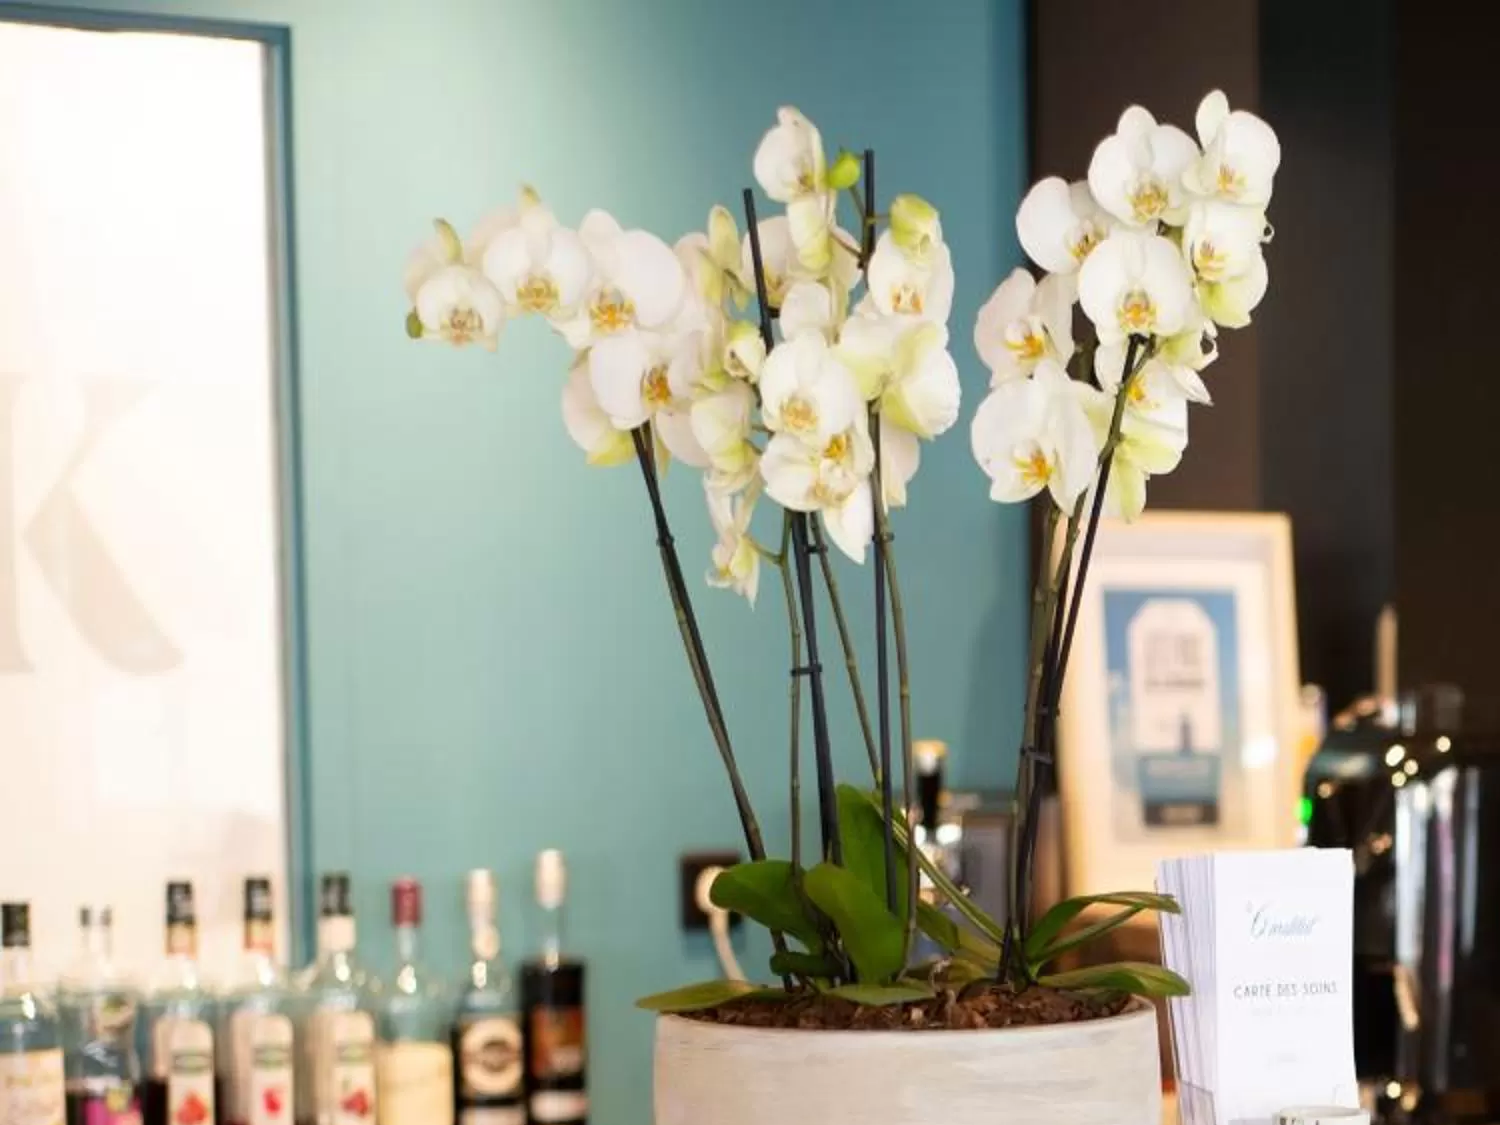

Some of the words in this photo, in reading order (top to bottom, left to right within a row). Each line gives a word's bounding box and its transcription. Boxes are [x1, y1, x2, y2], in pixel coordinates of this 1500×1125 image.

[1233, 982, 1272, 1000] CARTE
[1276, 982, 1297, 998] DES
[1302, 980, 1338, 995] SOINS
